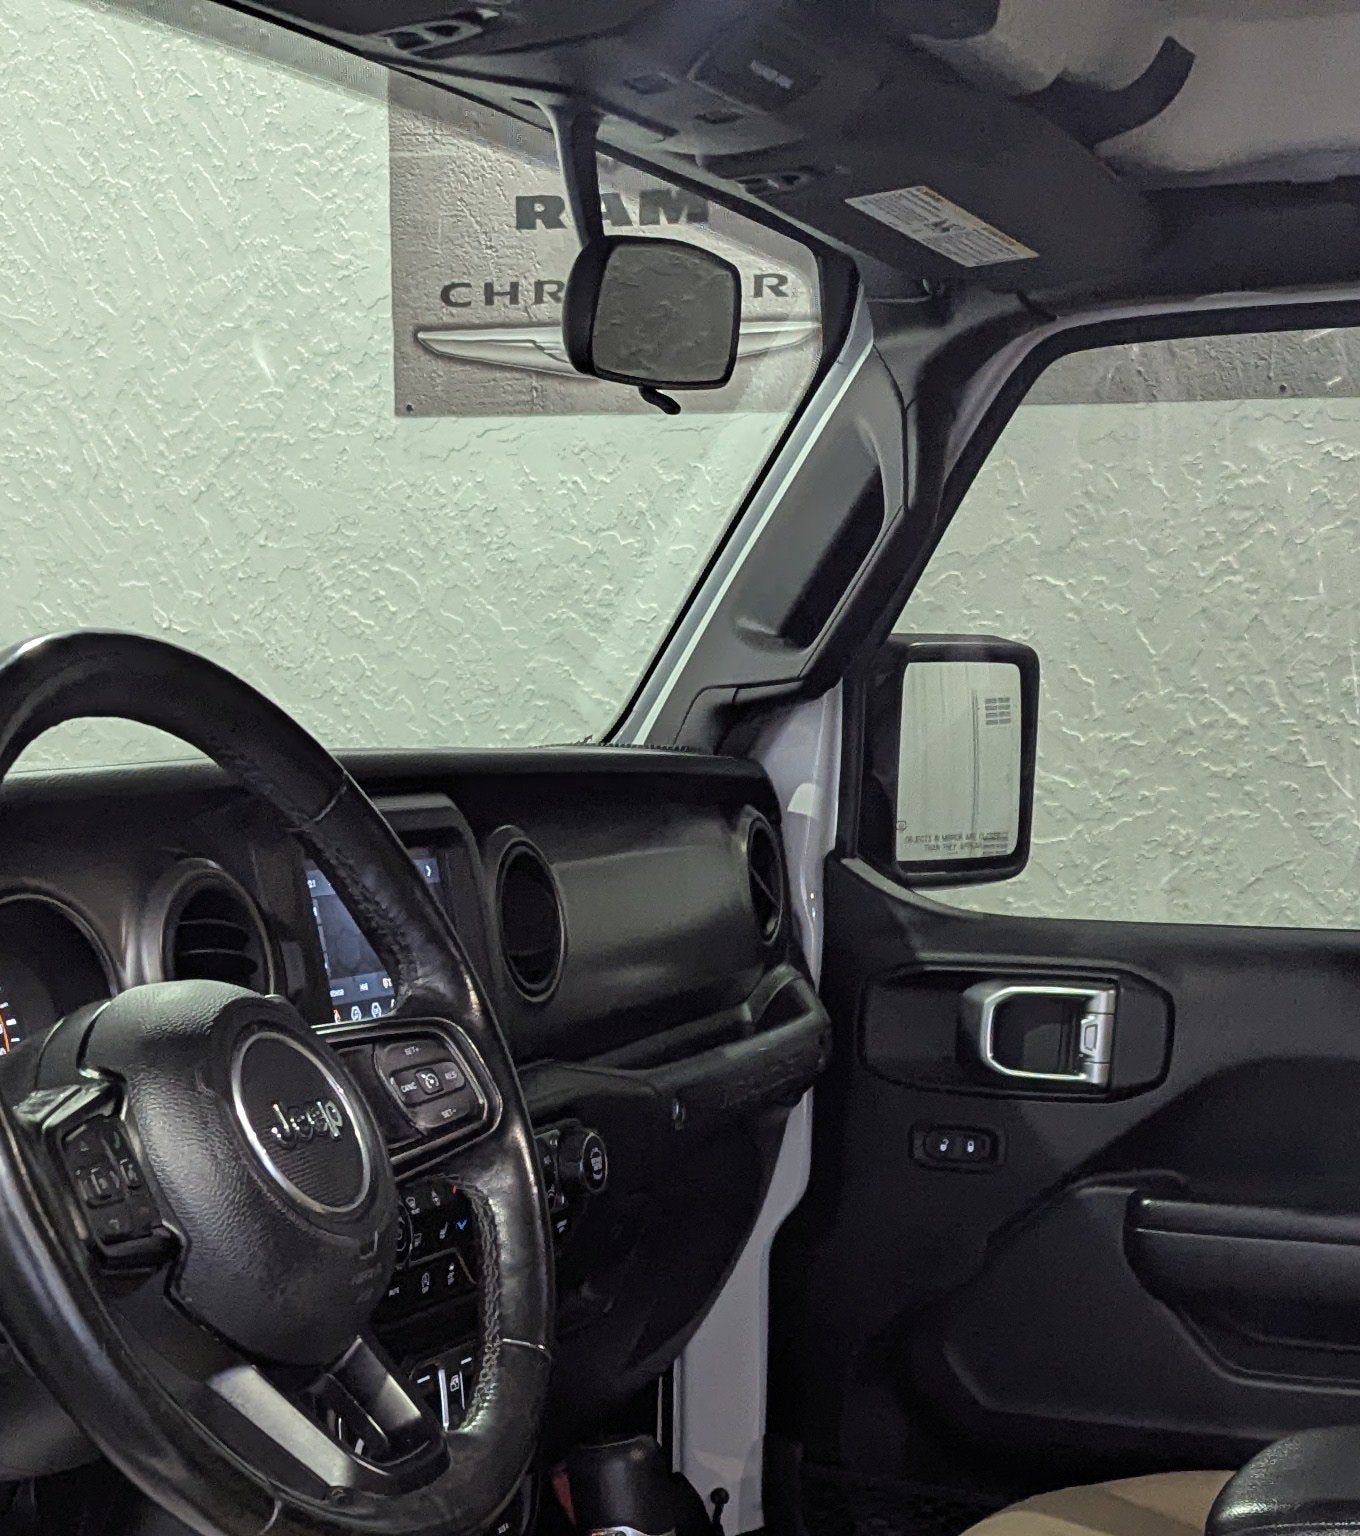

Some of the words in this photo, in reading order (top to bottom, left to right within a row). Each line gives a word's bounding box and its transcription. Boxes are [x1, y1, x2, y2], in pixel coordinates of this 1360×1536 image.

[516, 190, 710, 230] RAM
[440, 273, 790, 308] CHRR
[271, 1100, 343, 1149] Jeep
